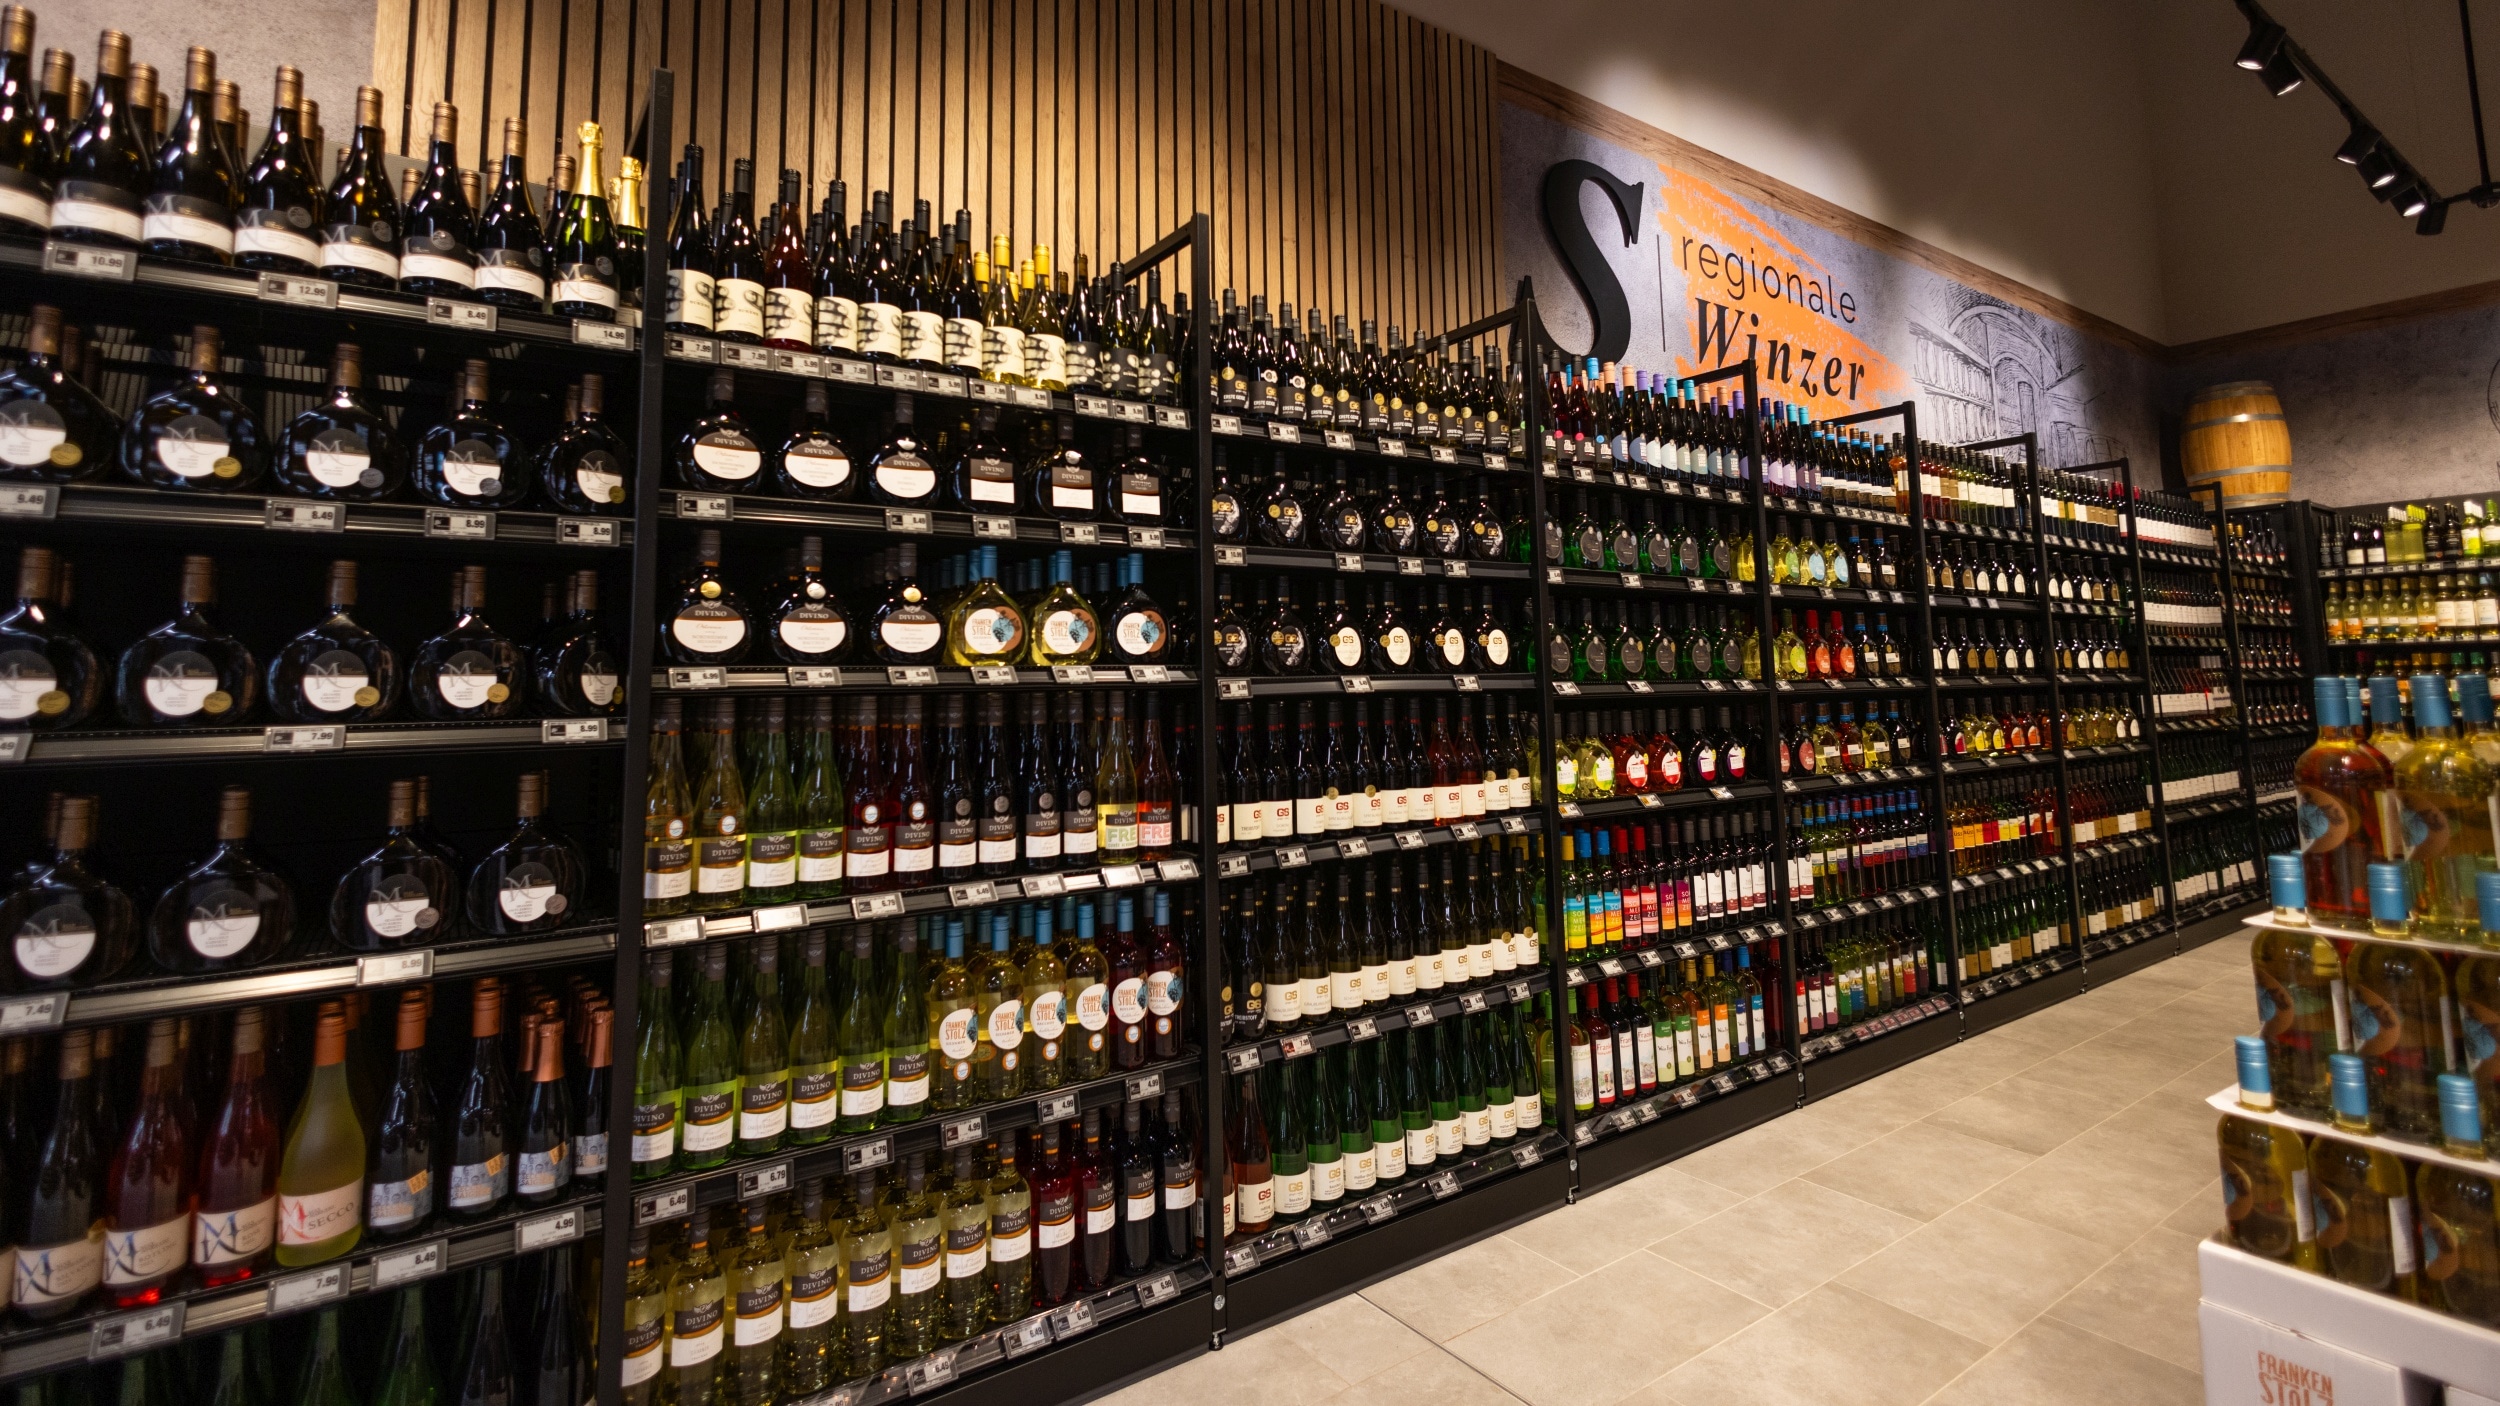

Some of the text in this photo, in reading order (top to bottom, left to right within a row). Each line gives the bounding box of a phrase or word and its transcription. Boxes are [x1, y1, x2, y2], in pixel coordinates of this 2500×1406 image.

[1510, 159, 1644, 366] S
[1682, 232, 1857, 324] regionale
[298, 284, 327, 297] 12.99
[467, 310, 486, 320] 8.49
[603, 329, 625, 340] 14.99
[1695, 297, 1865, 401] Winzer
[714, 436, 745, 448] DIVINO
[804, 447, 834, 457] DIVINO
[893, 459, 921, 468] DIVINO
[980, 465, 1005, 474] DIVINO
[1061, 473, 1084, 481] DIVINO
[312, 510, 334, 522] 8.49
[466, 519, 485, 529] 8.99
[593, 527, 611, 536] 8.99
[694, 610, 727, 618] DIVINO
[799, 612, 829, 620] DIVINO
[1342, 635, 1354, 644] GS
[1392, 635, 1405, 643] GS
[580, 723, 598, 733] 8.99
[311, 730, 333, 741] 7.99
[1397, 795, 1407, 805] GS
[1448, 792, 1460, 801] GS
[1335, 801, 1349, 811] GS
[1371, 798, 1381, 808] GS
[1277, 807, 1290, 817] GS
[1035, 819, 1058, 828] DIVINO
[1073, 816, 1095, 824] DIVINO
[949, 827, 974, 836] DIVINO
[988, 824, 1013, 833] DIVINO
[856, 834, 885, 844] DIVINO
[904, 830, 931, 839] DIVINO
[760, 843, 791, 852] DIVINO
[810, 839, 839, 848] DIVINO
[659, 851, 690, 862] DIVINO
[711, 848, 742, 857] DIVINO
[1481, 949, 1492, 959] GS
[1376, 971, 1388, 982] GS
[1149, 981, 1167, 990] FRANKEN
[1349, 978, 1362, 988] GS
[1118, 988, 1137, 998] FRANKEN
[1285, 990, 1298, 1001] GS
[1316, 984, 1329, 996] GS
[1082, 994, 1101, 1003] FRANKEN
[26, 1003, 52, 1016] 7.49
[1036, 1002, 1056, 1012] FRANKEN
[995, 1012, 1015, 1022] FRANKEN
[945, 1020, 967, 1031] FRANKEN
[898, 1060, 925, 1072] DIVINO
[853, 1069, 881, 1080] DIVINO
[801, 1081, 831, 1093] DIVINO
[1148, 1078, 1159, 1088] 4.99
[752, 1090, 783, 1102] DIVINO
[694, 1102, 727, 1113] DIVINO
[1062, 1099, 1074, 1109] 4.99
[1525, 1100, 1537, 1110] GS
[1503, 1109, 1514, 1120] GS
[968, 1122, 981, 1132] 4.99
[872, 1145, 886, 1156] 6.79
[1391, 1147, 1402, 1158] GS
[1359, 1158, 1372, 1169] GS
[770, 1170, 786, 1182] 6.79
[1328, 1168, 1341, 1179] GS
[1288, 1181, 1303, 1193] GS
[1258, 1188, 1271, 1201] GS
[669, 1194, 687, 1207] 6.49
[1049, 1203, 1072, 1215] DIVINO
[308, 1203, 355, 1230] SECCO
[555, 1218, 574, 1231] 4.99
[1001, 1216, 1026, 1229] DIVINO
[957, 1230, 983, 1244] DIVINO
[913, 1243, 938, 1258] DIVINO
[415, 1251, 436, 1265] 8.49
[860, 1260, 888, 1274] DIVINO
[314, 1274, 338, 1289] 7.99
[802, 1275, 832, 1291] DIVINO
[1160, 1279, 1172, 1290] 6.99
[748, 1290, 779, 1307] DIVINO
[686, 1309, 718, 1325] DIVINO
[1077, 1309, 1090, 1321] 6.99
[145, 1315, 170, 1331] 6.49
[629, 1326, 661, 1345] DIVINO
[1029, 1326, 1042, 1338] 6.49
[935, 1361, 949, 1373] 6.49
[2258, 1350, 2333, 1398] FRANKEN
